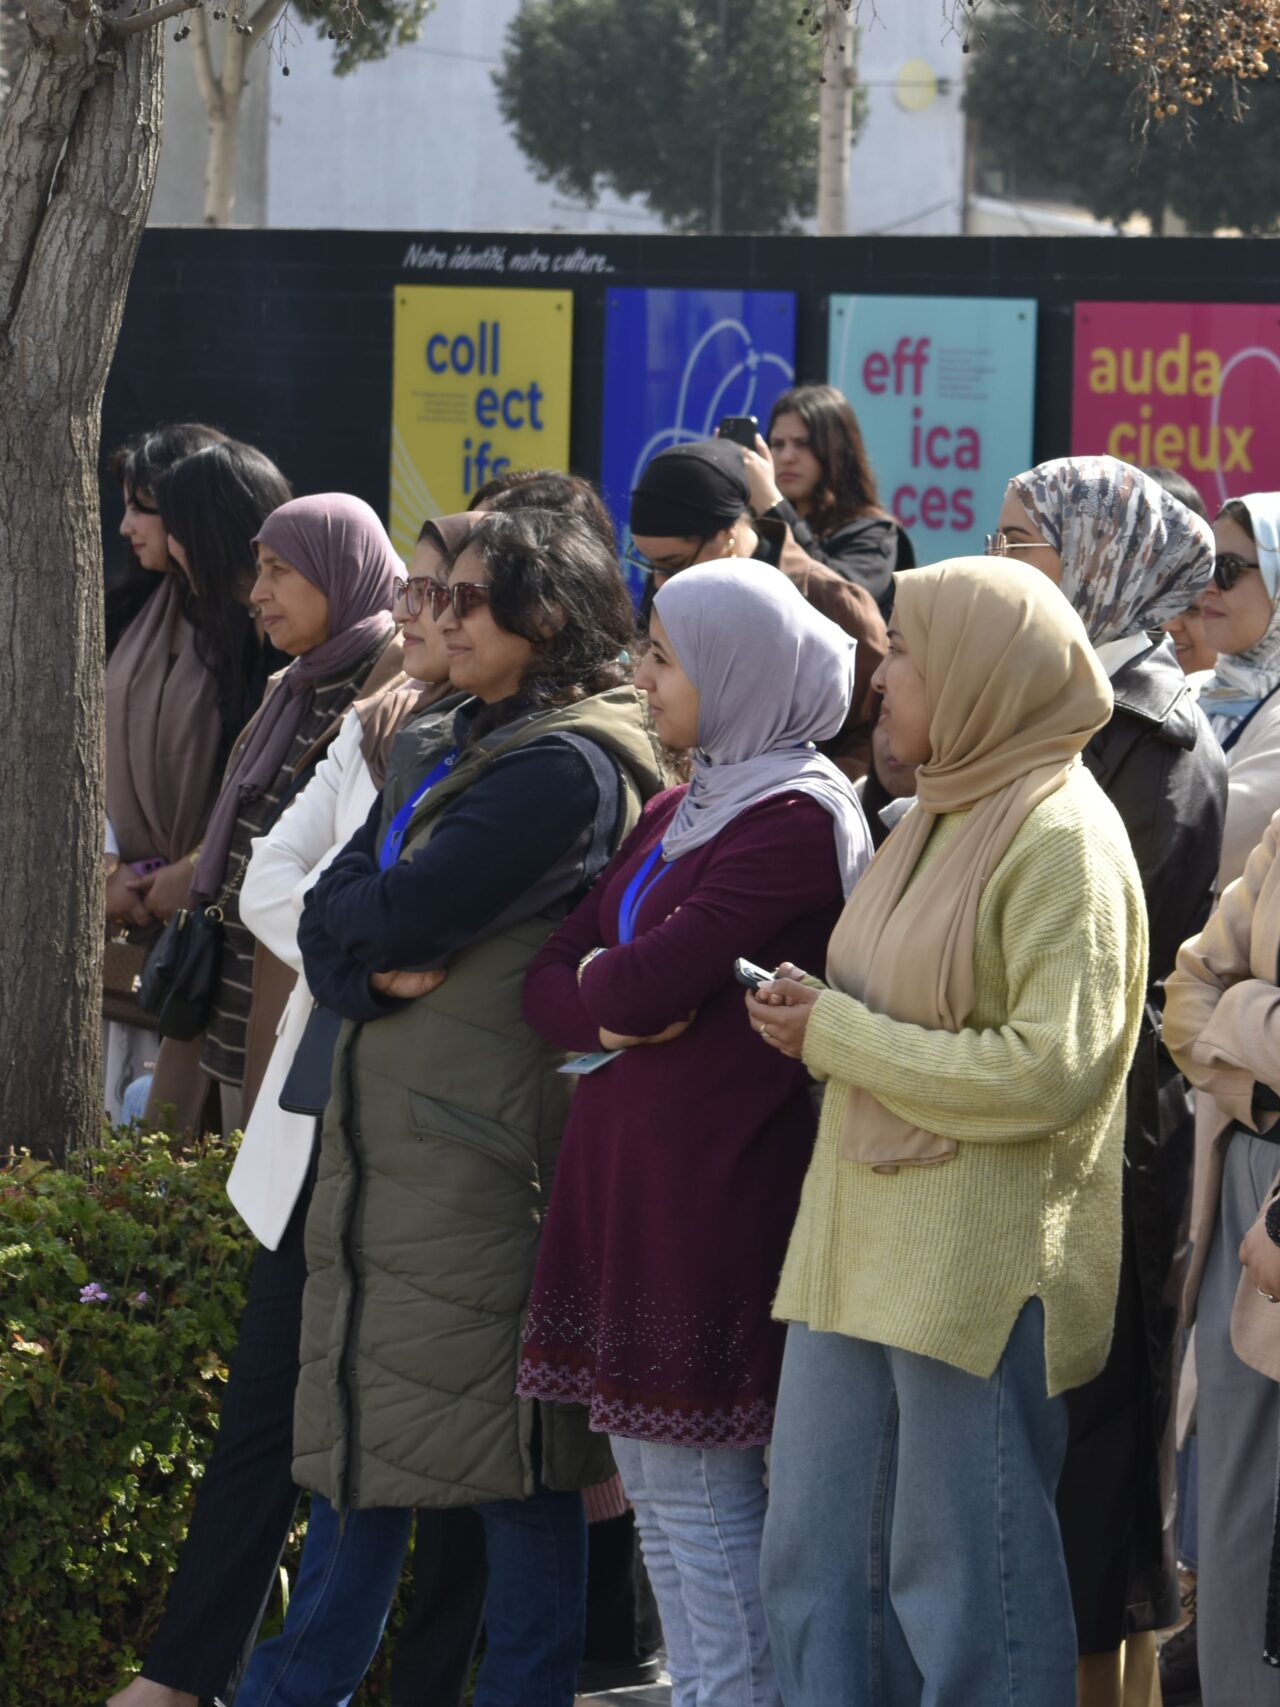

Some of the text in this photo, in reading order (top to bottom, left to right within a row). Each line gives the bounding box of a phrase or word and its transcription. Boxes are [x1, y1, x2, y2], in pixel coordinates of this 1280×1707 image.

[403, 243, 447, 270] Notre
[508, 249, 550, 272] notre
[426, 321, 500, 376] coll
[862, 337, 931, 396] eff
[1088, 333, 1222, 396] auda
[475, 382, 544, 431] ect
[911, 407, 980, 470] ica
[1107, 403, 1254, 473] cieux
[892, 484, 975, 531] ces
